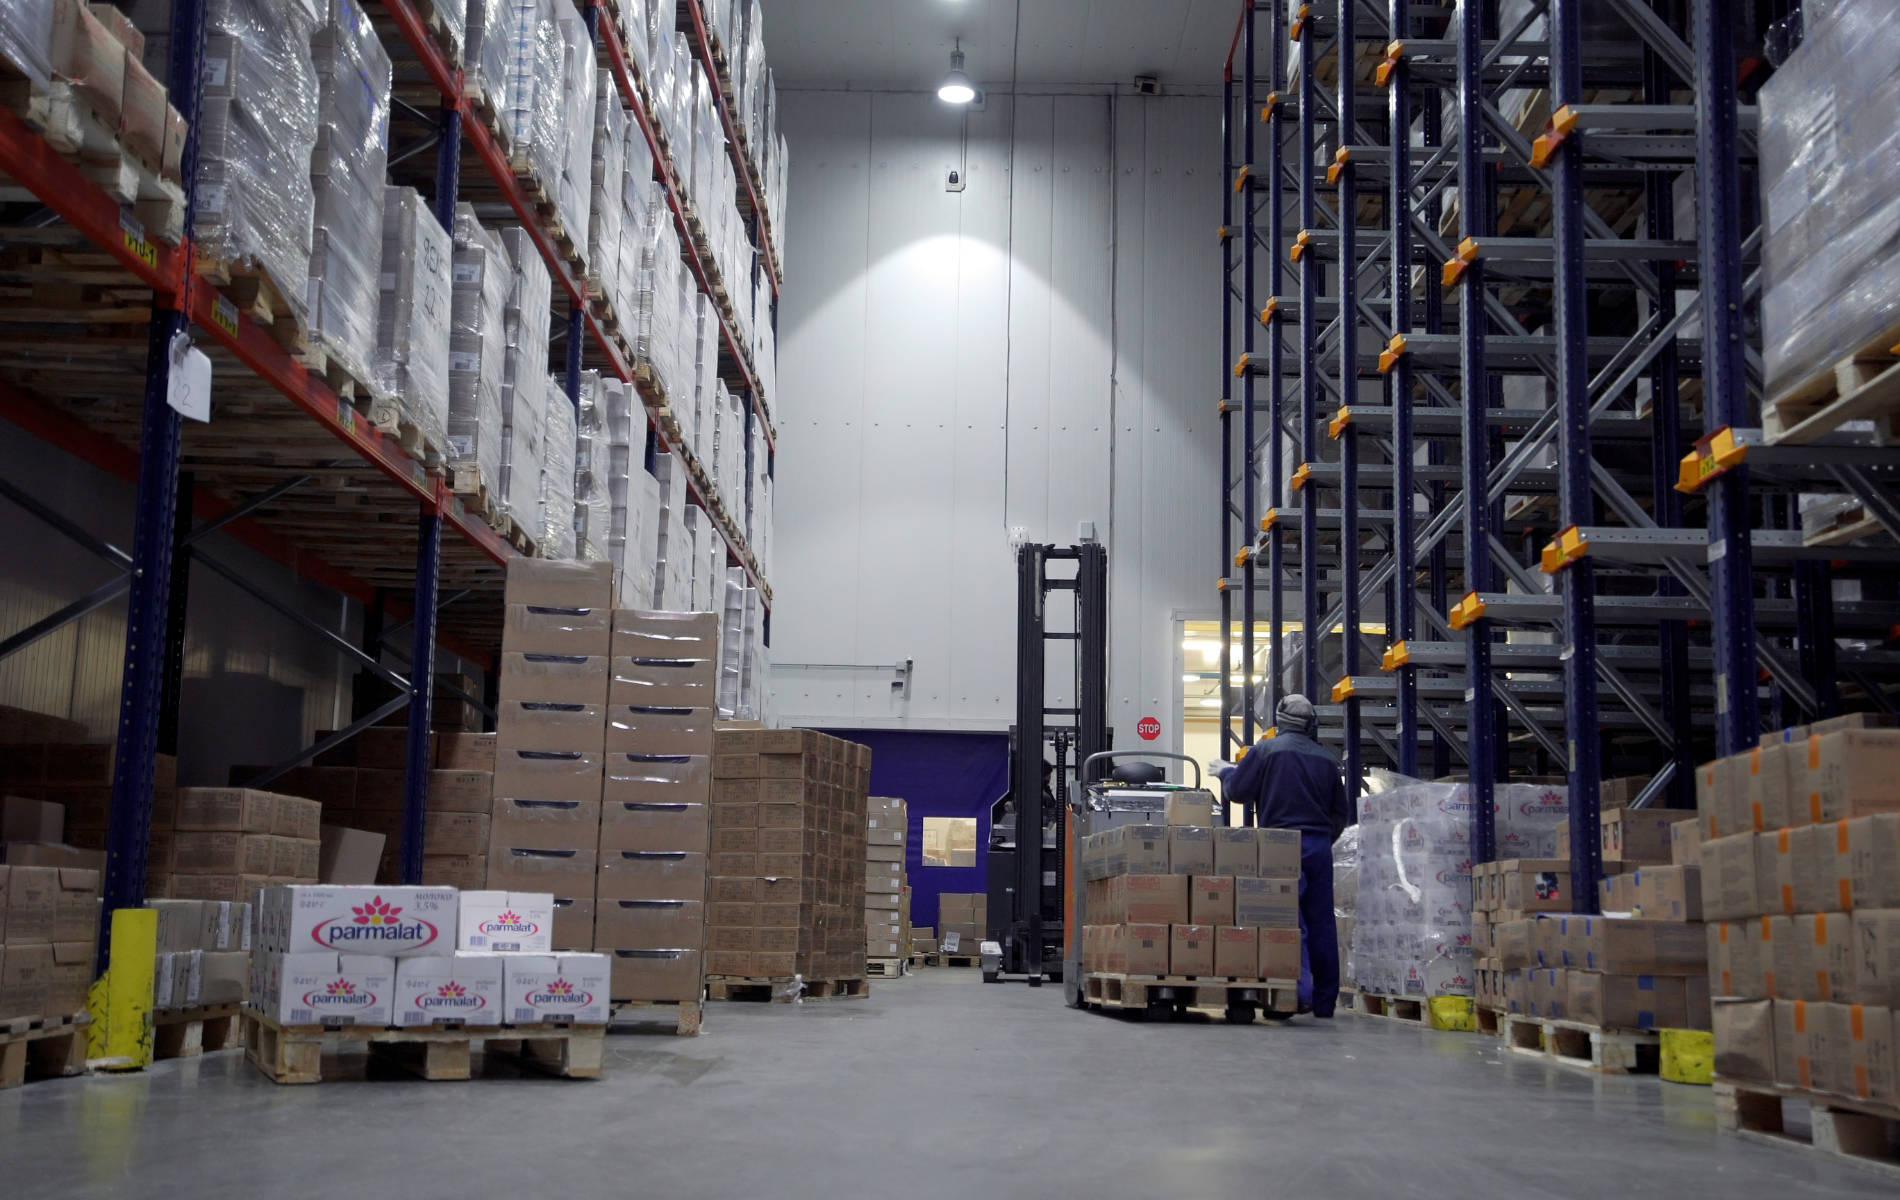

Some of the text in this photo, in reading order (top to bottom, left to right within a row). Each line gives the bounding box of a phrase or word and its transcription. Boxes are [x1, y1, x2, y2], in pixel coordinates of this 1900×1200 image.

[1138, 723, 1160, 734] STOP
[1528, 804, 1569, 814] parmala
[329, 923, 424, 944] parmalat
[486, 923, 532, 933] parmalat
[312, 993, 368, 1006] parmalat
[424, 996, 478, 1008] parmalat
[533, 993, 586, 1006] parmalat
